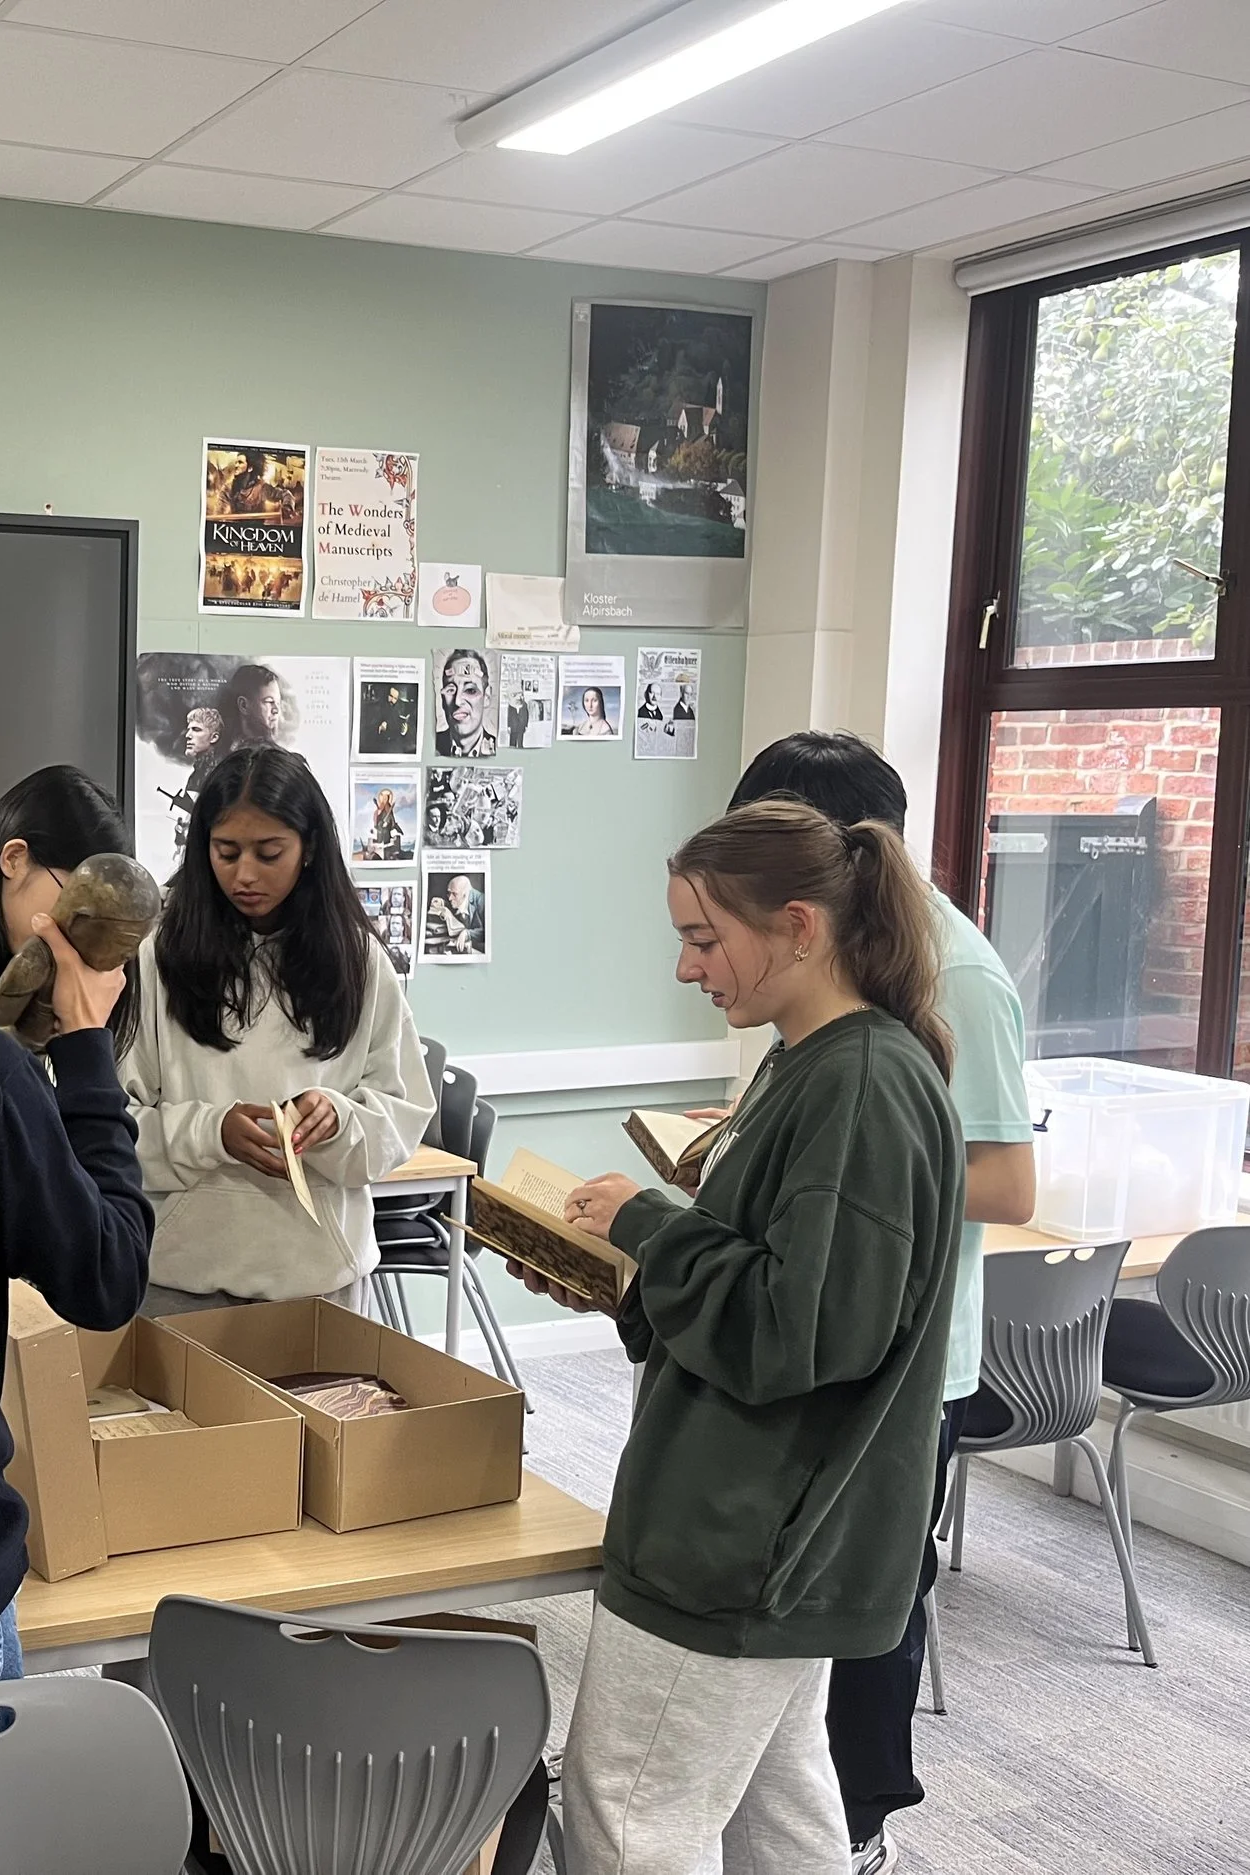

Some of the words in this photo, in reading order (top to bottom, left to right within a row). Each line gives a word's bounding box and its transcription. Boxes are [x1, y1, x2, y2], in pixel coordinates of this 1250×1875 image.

[318, 502, 344, 517] The
[348, 503, 404, 520] Wonders
[212, 523, 295, 544] KINGDOM
[317, 521, 332, 535] of
[334, 522, 392, 538] Medieval
[240, 541, 284, 553] HEAVEN
[318, 541, 394, 560] Manuscripts
[320, 575, 372, 590] Christopher
[318, 591, 329, 602] de
[331, 592, 361, 604] Hamel
[583, 591, 618, 605] Kloster
[582, 604, 633, 618] Alpirsbach
